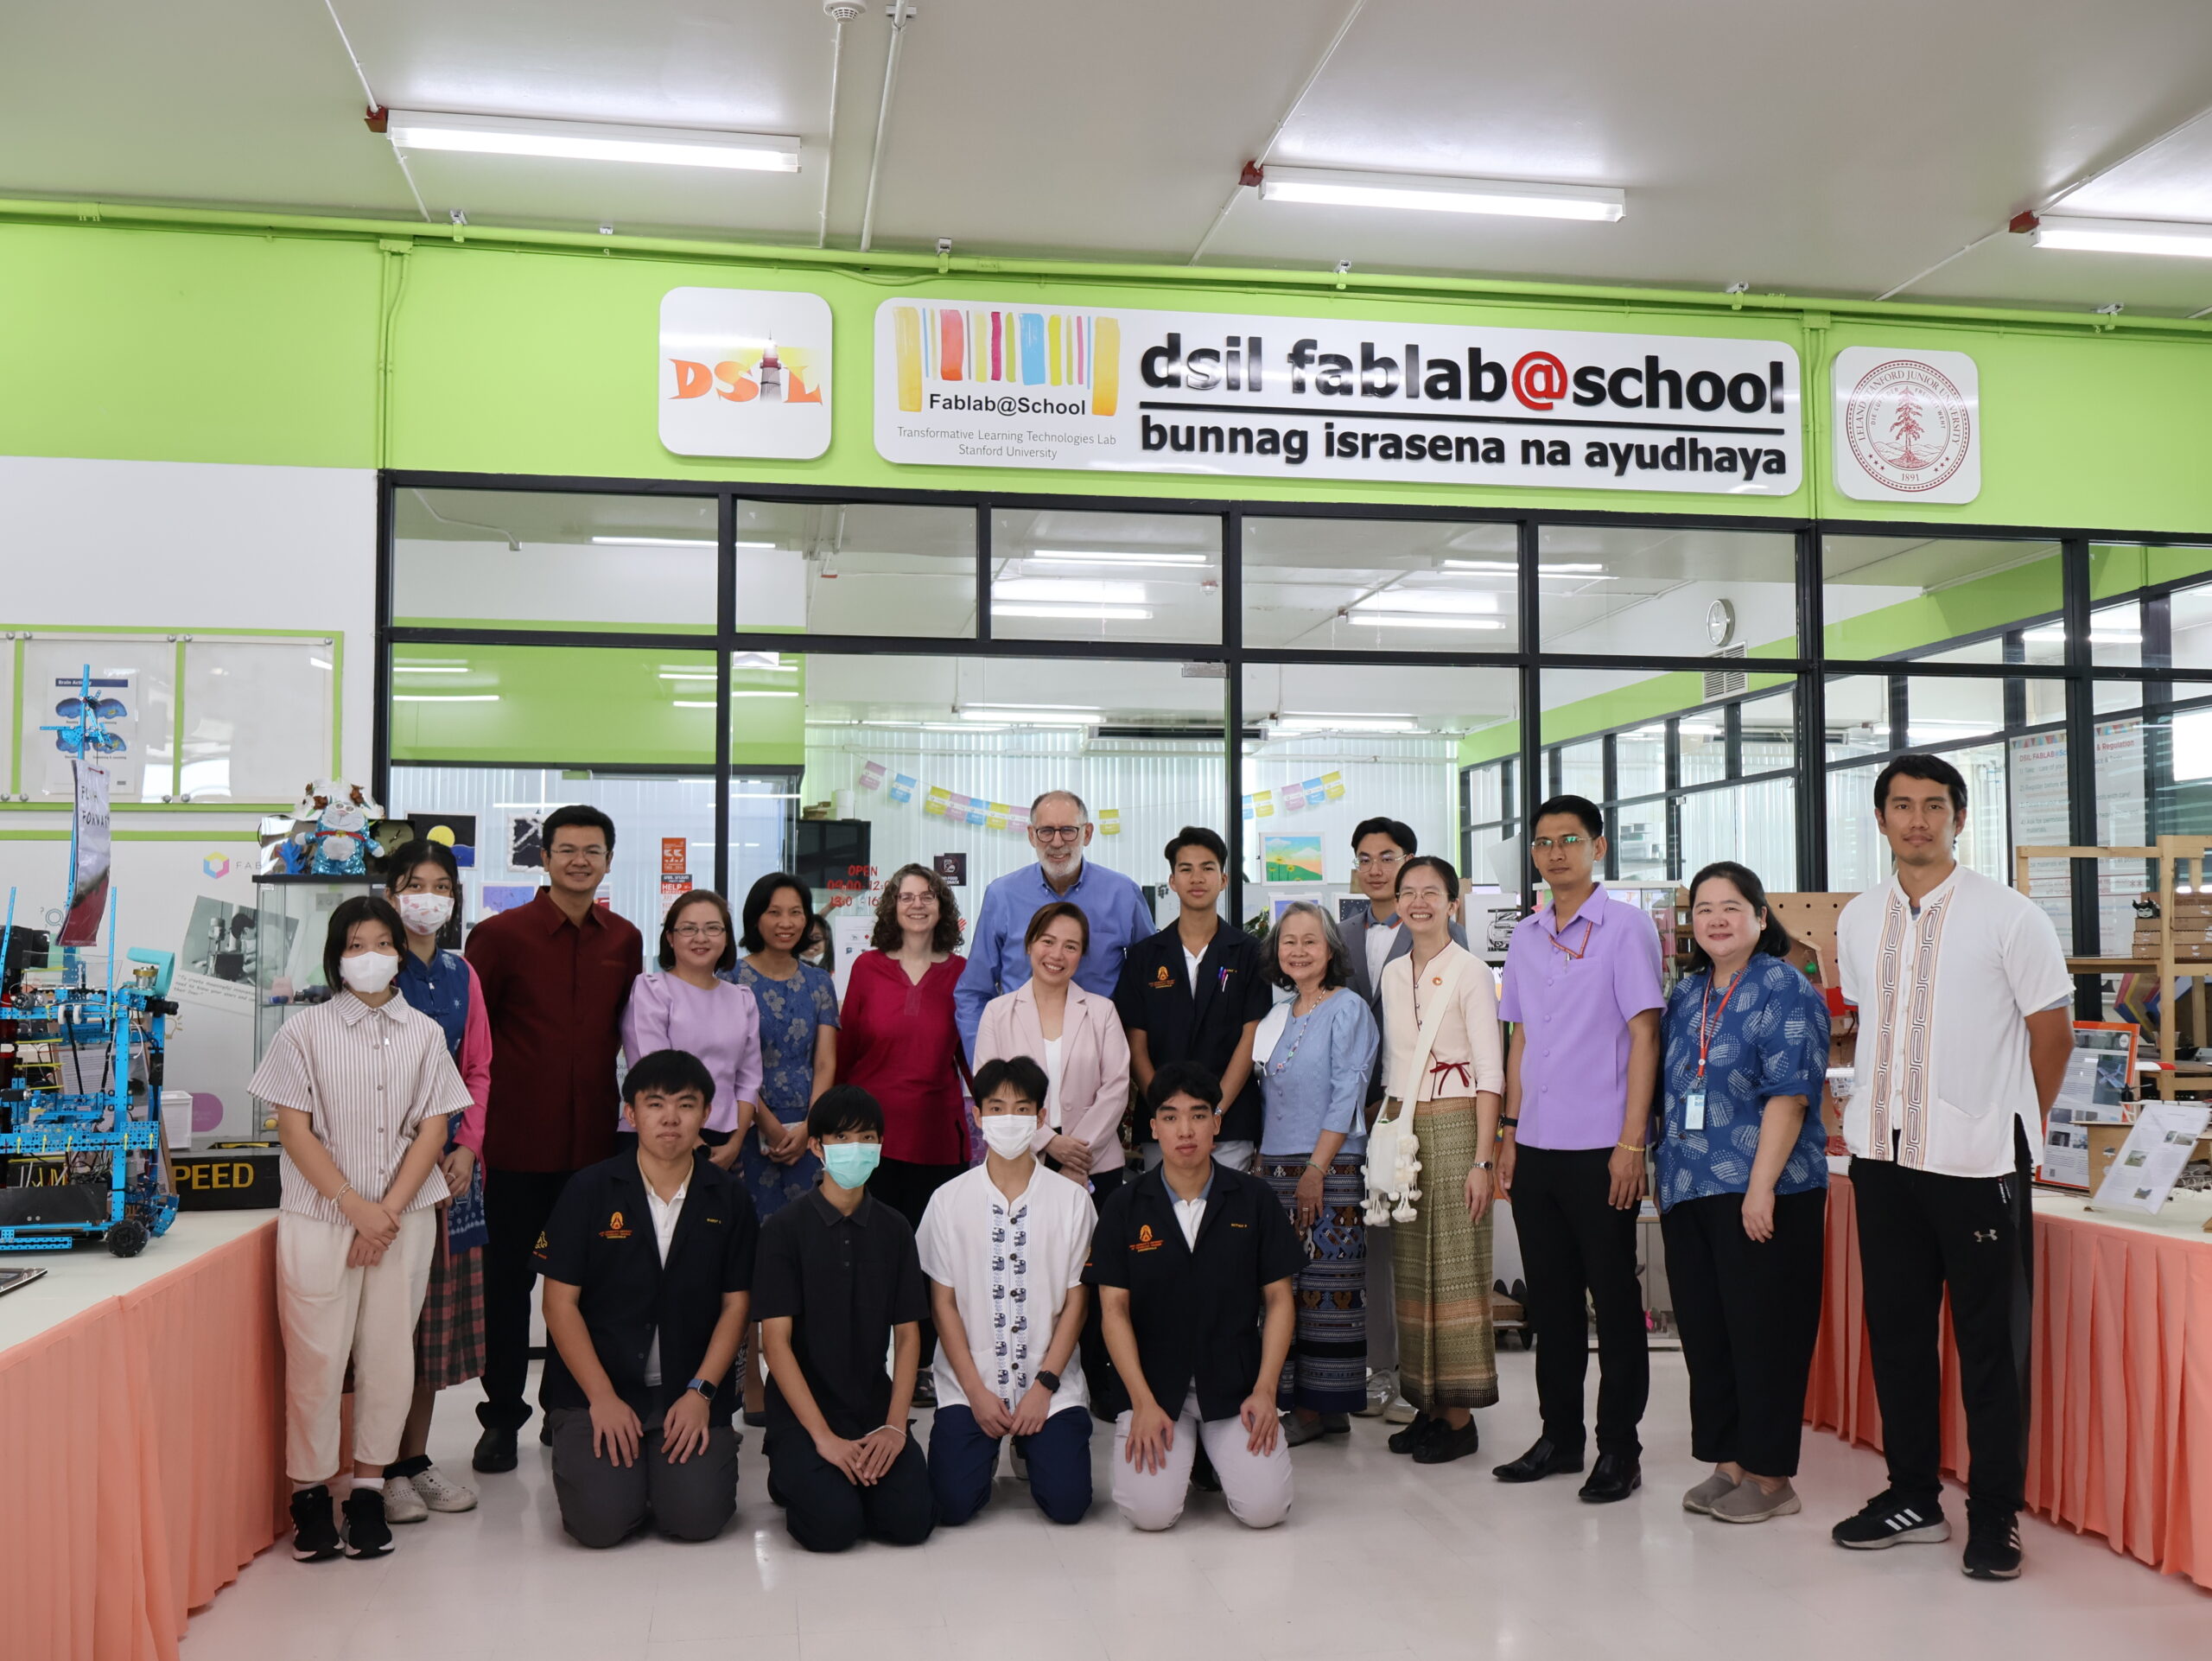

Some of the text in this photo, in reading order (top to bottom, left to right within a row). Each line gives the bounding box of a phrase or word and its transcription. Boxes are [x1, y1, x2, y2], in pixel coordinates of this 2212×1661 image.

[1140, 332, 1784, 415] dsil fablab@school
[1906, 370, 1940, 390] JUNIOR
[929, 393, 1086, 417] Fablab@School
[897, 426, 1117, 446] Transformative Learning Technologies Lab
[958, 443, 1058, 460] Stanford University
[1141, 414, 1788, 482] bunnag israsena na ayudhaya
[1900, 473, 1920, 481] 1891
[848, 864, 878, 876] OPEN
[173, 1162, 254, 1190] PEED
